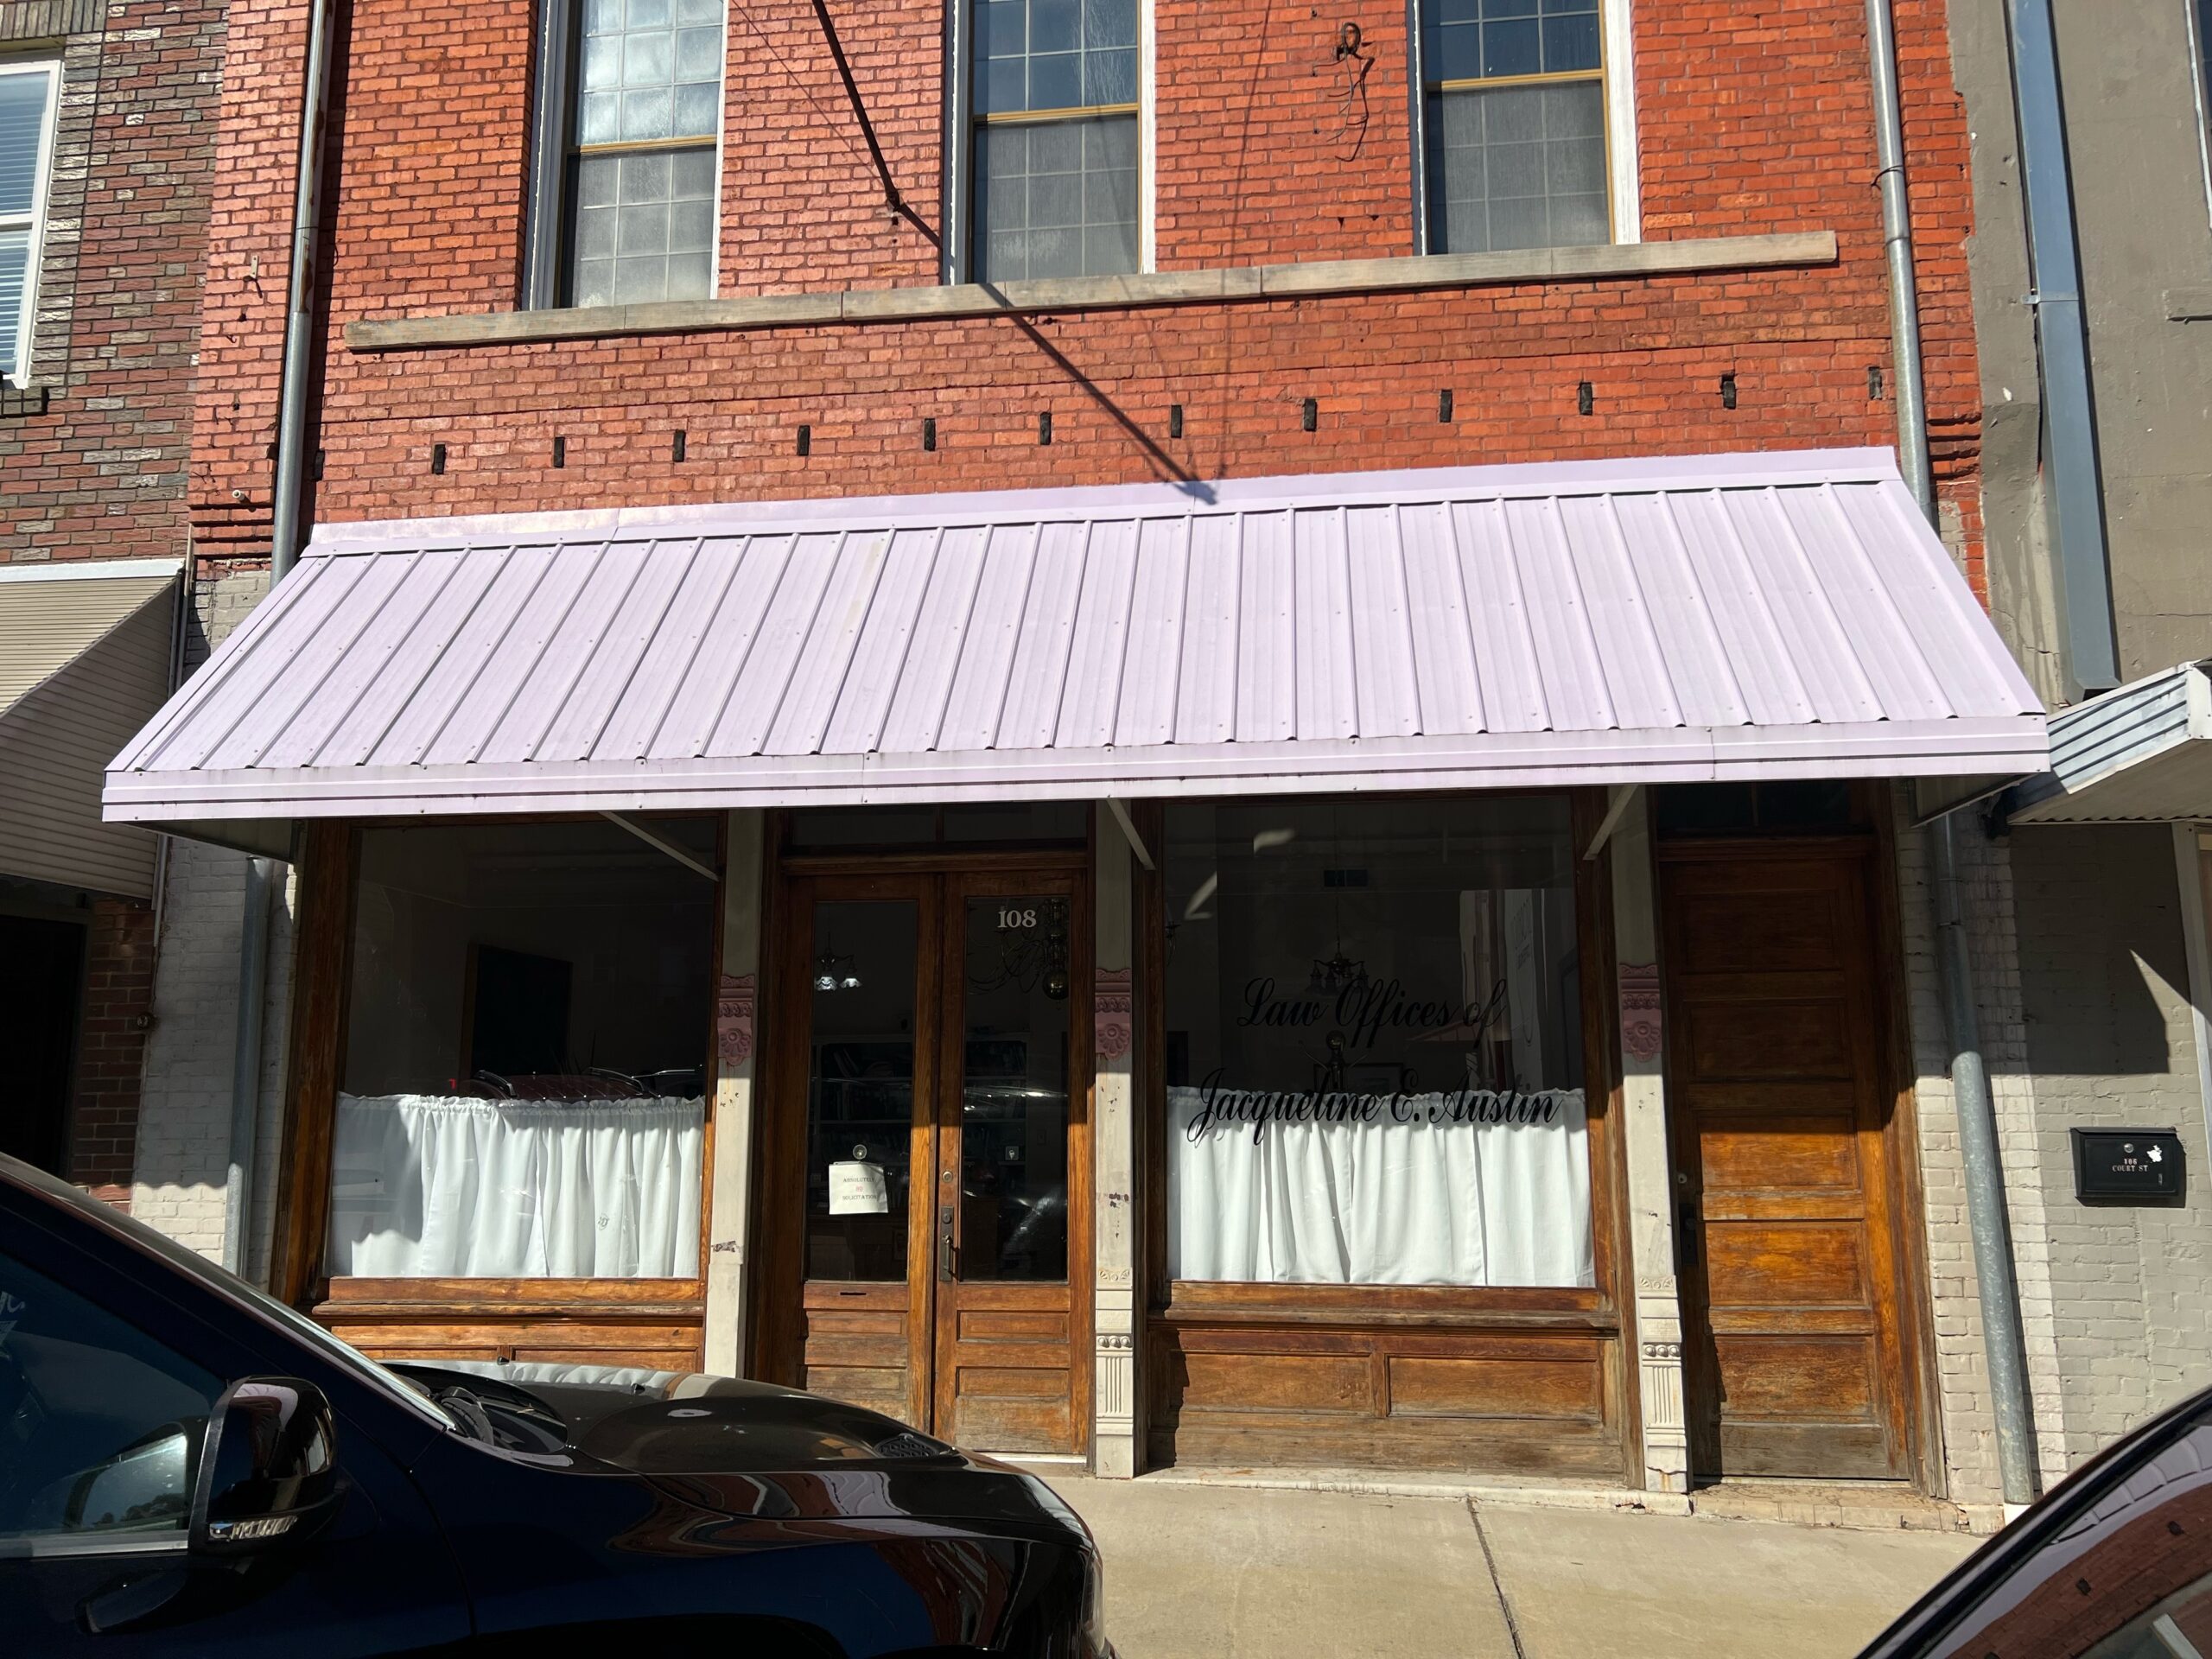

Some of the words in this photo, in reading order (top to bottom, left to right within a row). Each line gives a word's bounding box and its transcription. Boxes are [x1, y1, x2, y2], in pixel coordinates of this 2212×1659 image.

[997, 909, 1037, 928] 108
[1237, 977, 1328, 1027] Law
[1336, 977, 1460, 1048] Offices
[1464, 978, 1507, 1048] of
[1187, 1067, 1387, 1146] Jacqueline
[1390, 1068, 1420, 1122] E.
[1428, 1070, 1564, 1123] Austin
